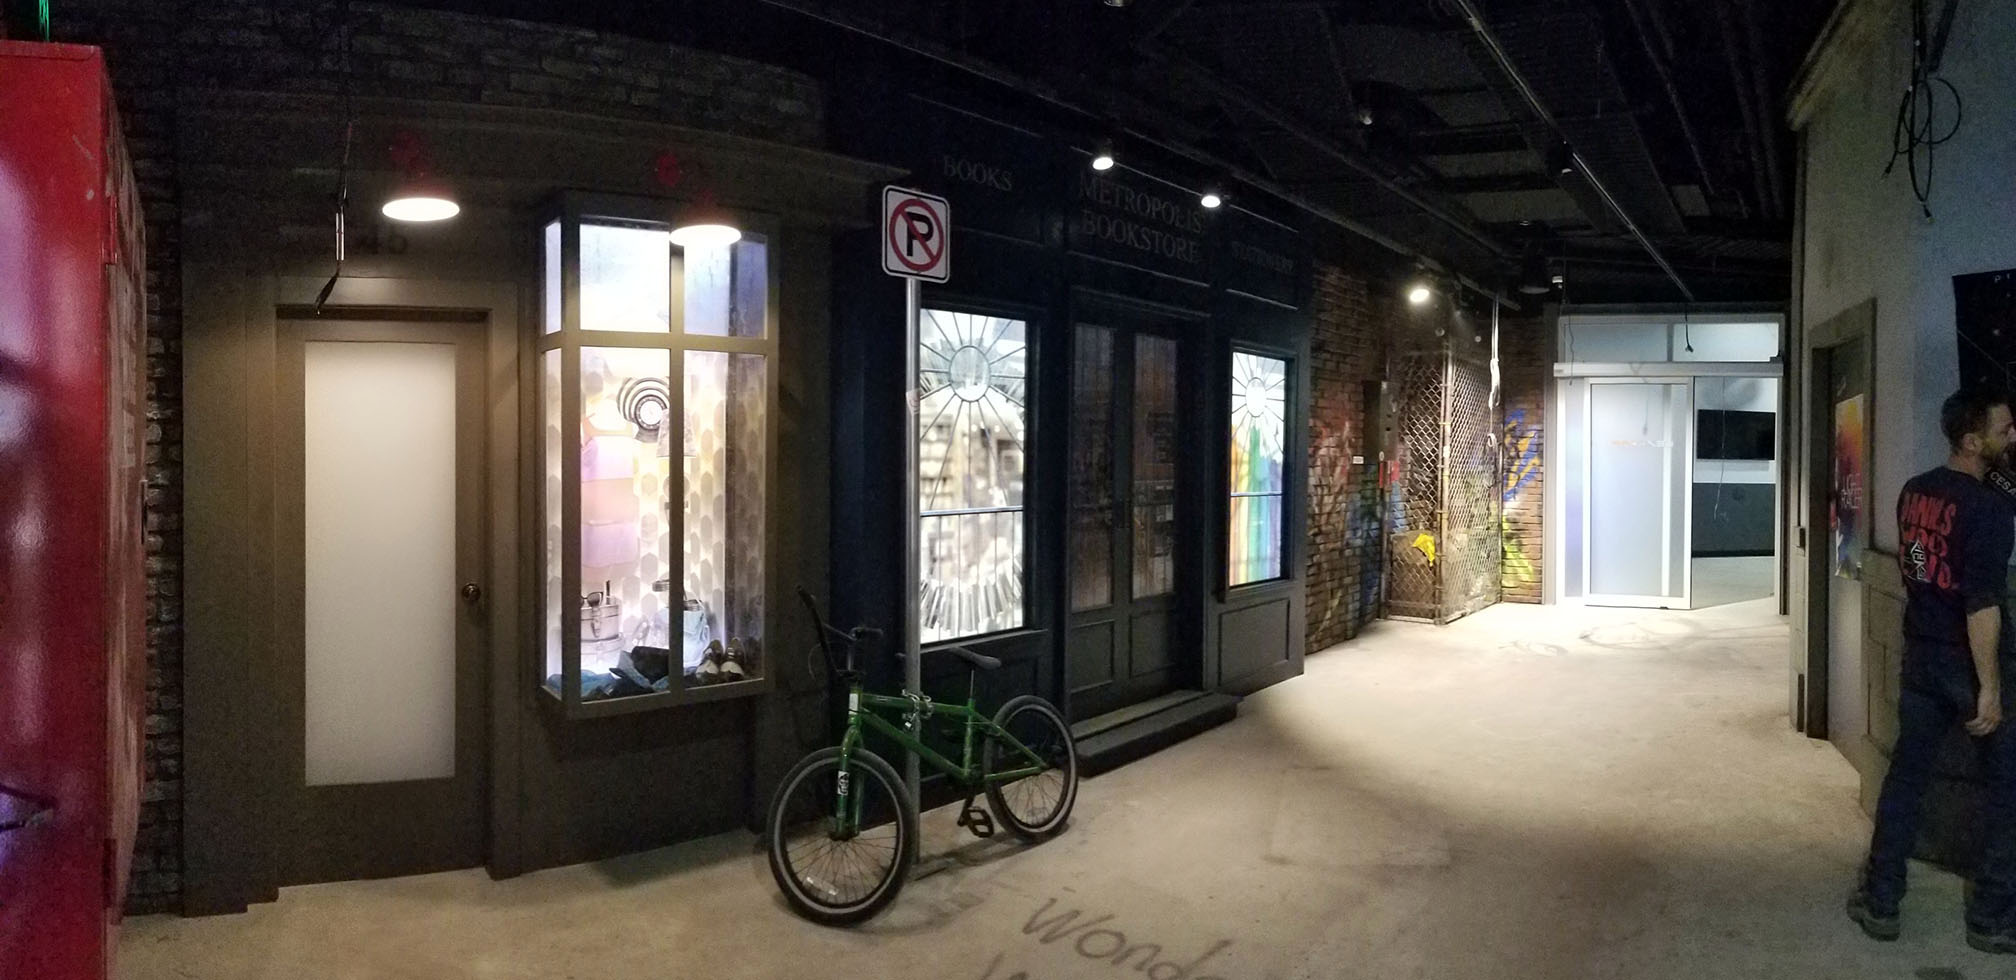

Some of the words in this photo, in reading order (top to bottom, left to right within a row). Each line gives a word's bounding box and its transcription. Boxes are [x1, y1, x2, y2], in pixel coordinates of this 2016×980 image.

[943, 154, 1013, 193] BOOKS
[1080, 173, 1205, 234] METROPOLIS
[906, 211, 934, 257] P
[1081, 210, 1205, 263] BOOKSTORE
[1022, 897, 1231, 980] Wond
